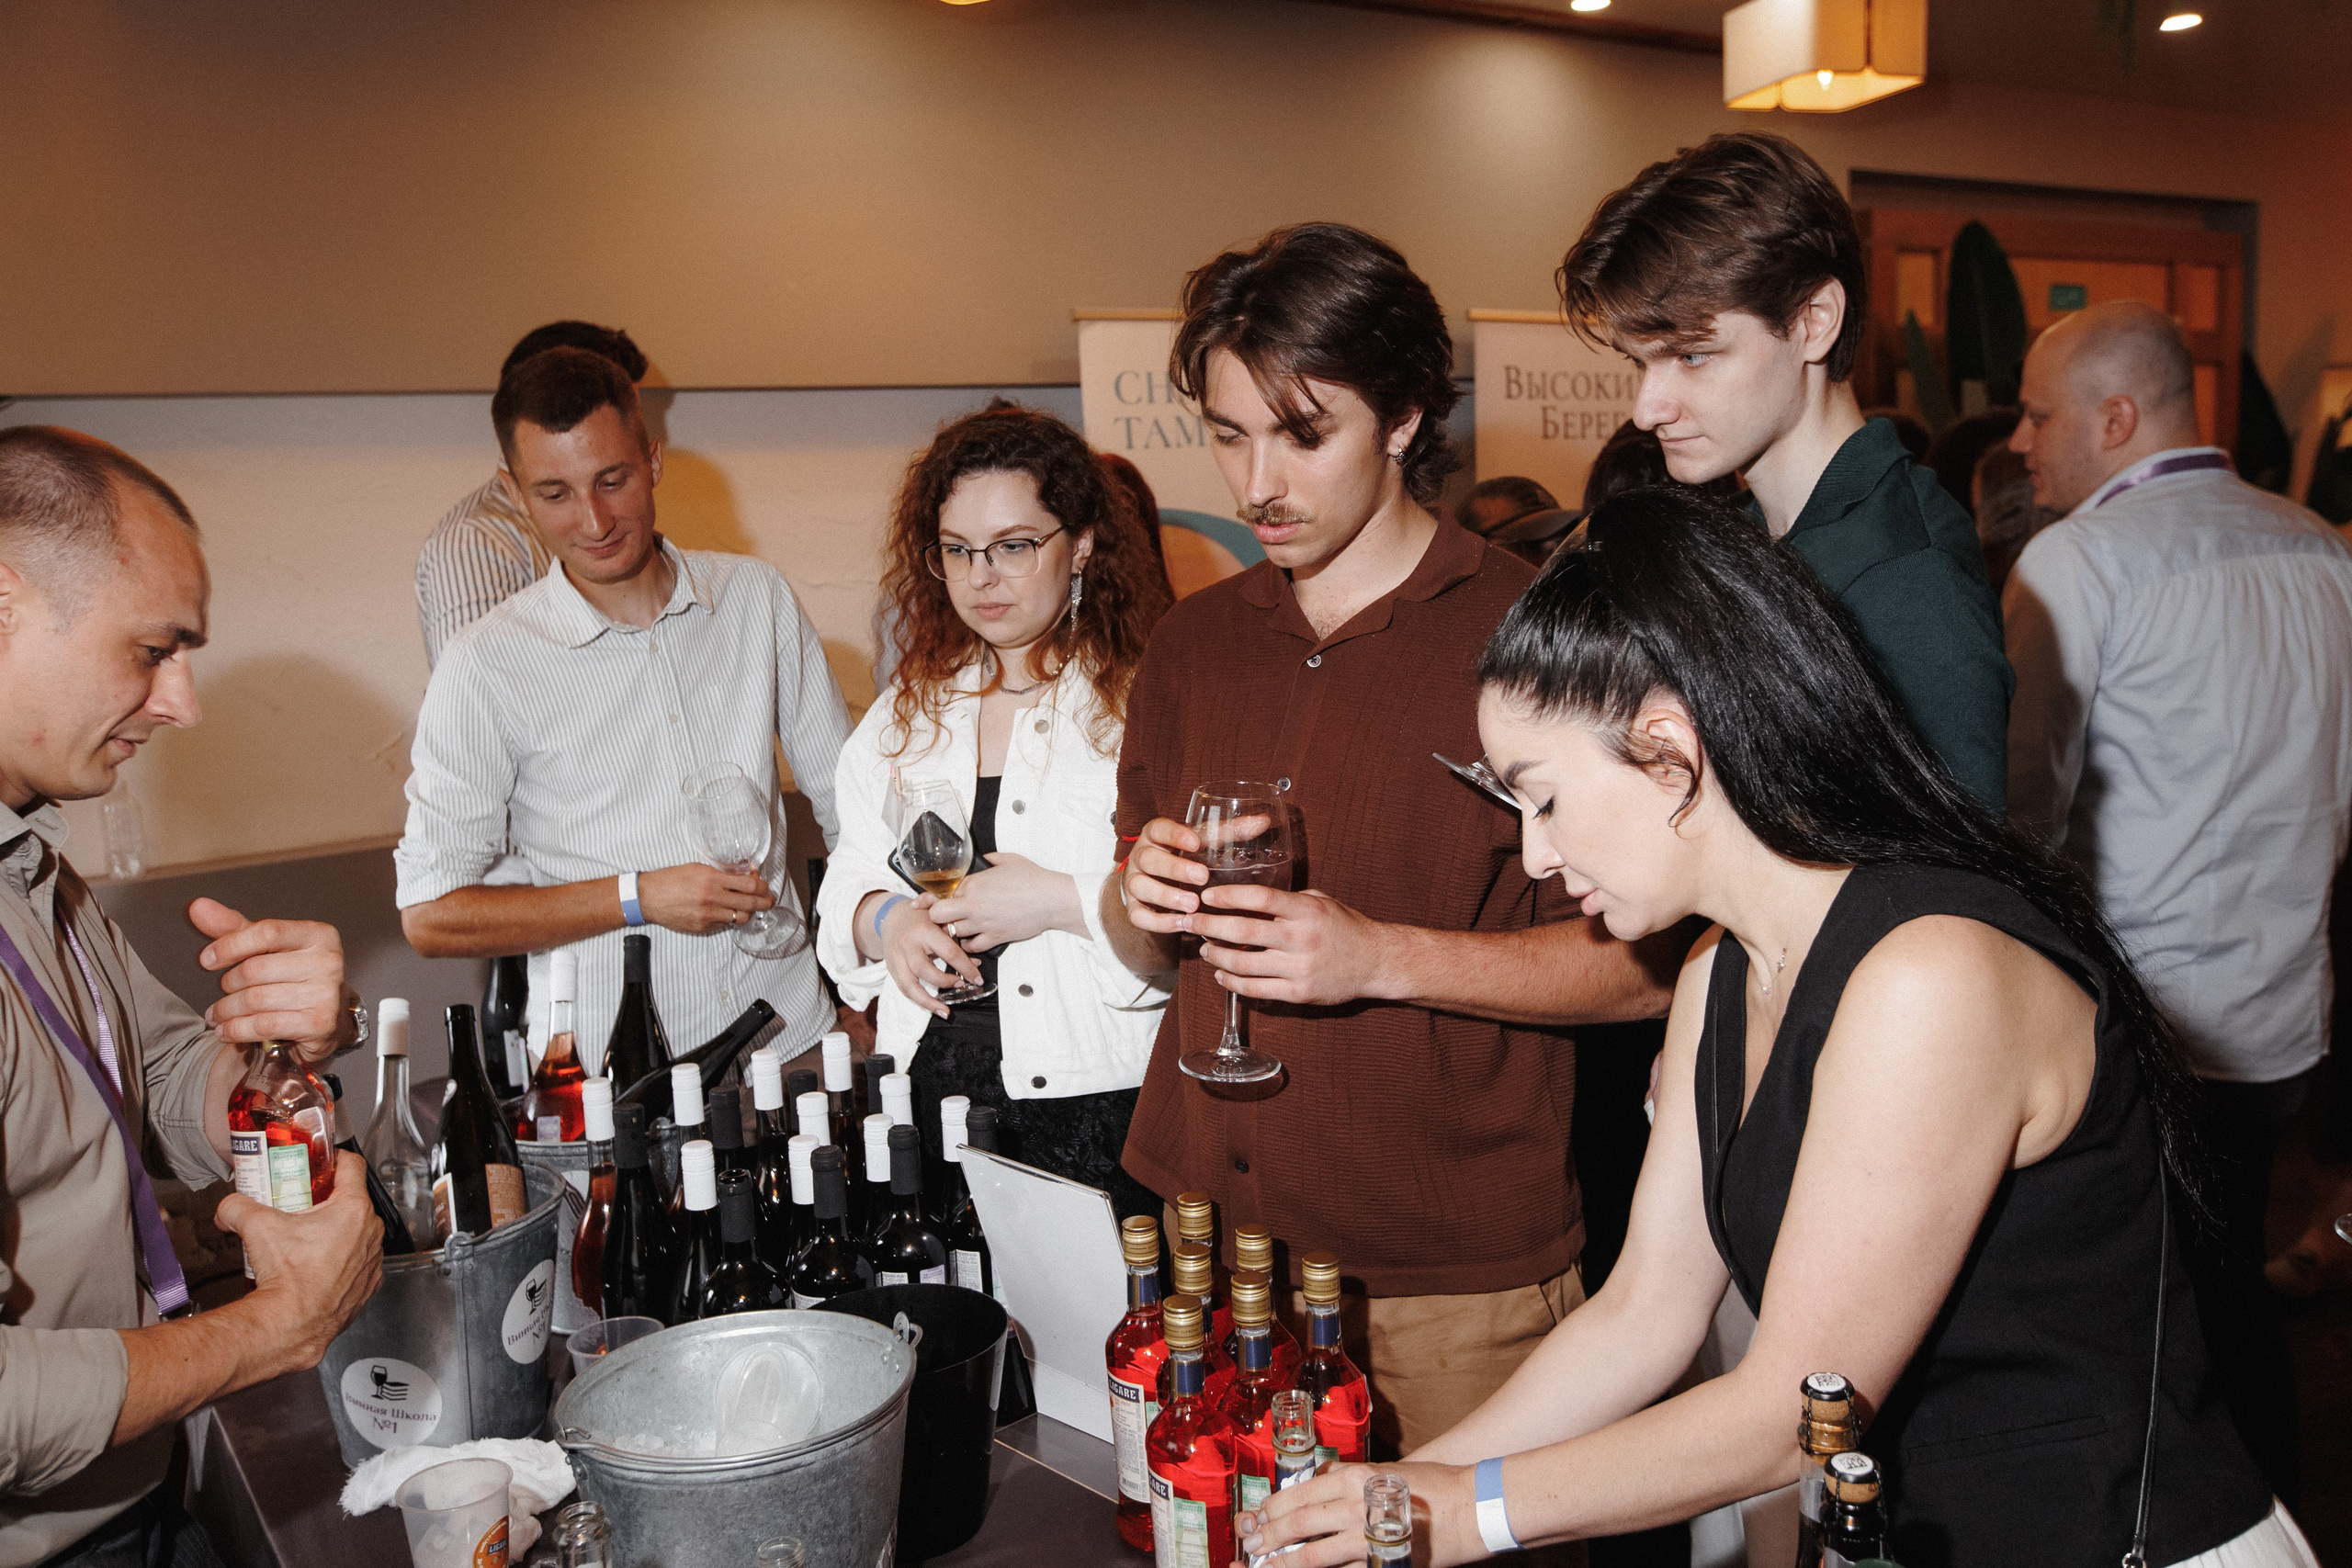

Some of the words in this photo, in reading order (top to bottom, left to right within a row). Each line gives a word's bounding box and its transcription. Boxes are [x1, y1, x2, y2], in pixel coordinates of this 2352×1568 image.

[1114, 369, 1173, 405] CH
[1505, 365, 1634, 400] ВЫСОКИ
[1113, 415, 1205, 450] TAM
[1541, 405, 1625, 440] БЕРЕГ
[232, 1139, 258, 1152] IGARE
[1109, 1379, 1136, 1400] LIGARE
[391, 1408, 436, 1421] Школа
